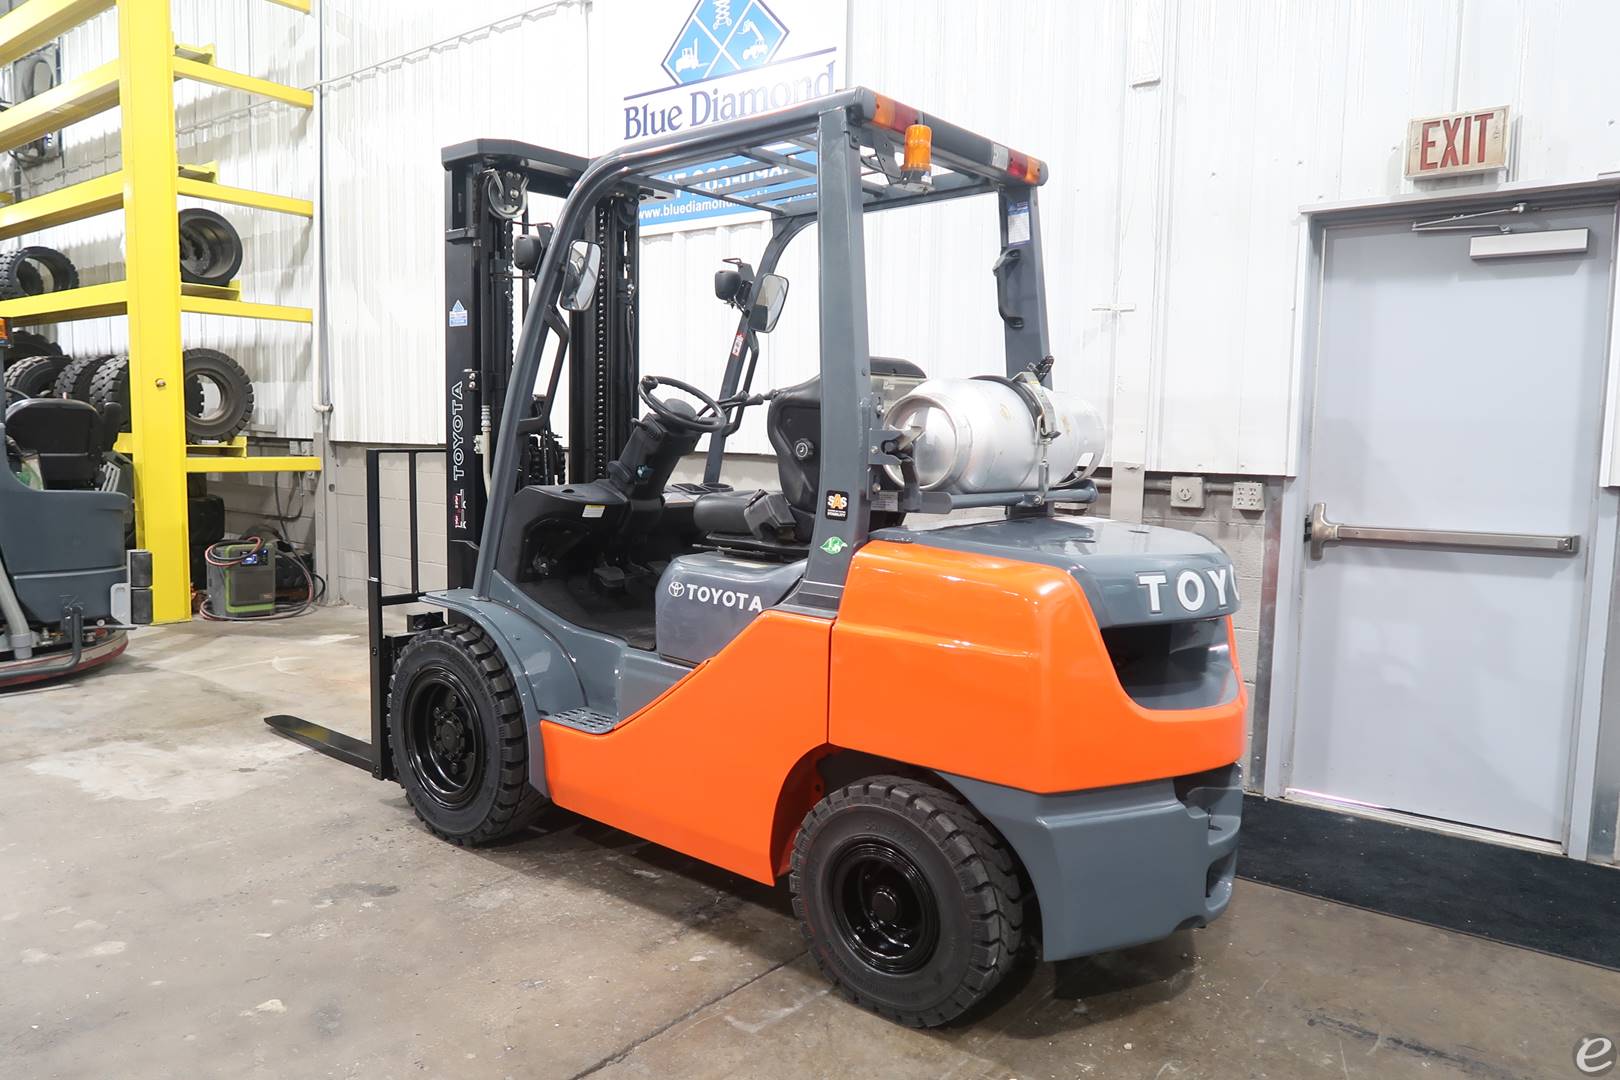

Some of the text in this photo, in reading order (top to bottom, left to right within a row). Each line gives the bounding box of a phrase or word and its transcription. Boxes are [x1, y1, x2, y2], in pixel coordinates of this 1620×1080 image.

[624, 60, 836, 140] Blue Diamond
[1420, 112, 1495, 171] EXIT
[451, 380, 465, 481] TOYOTA
[827, 493, 848, 510] SAS
[686, 583, 763, 613] TOYOTA
[1137, 564, 1240, 612] TOY
